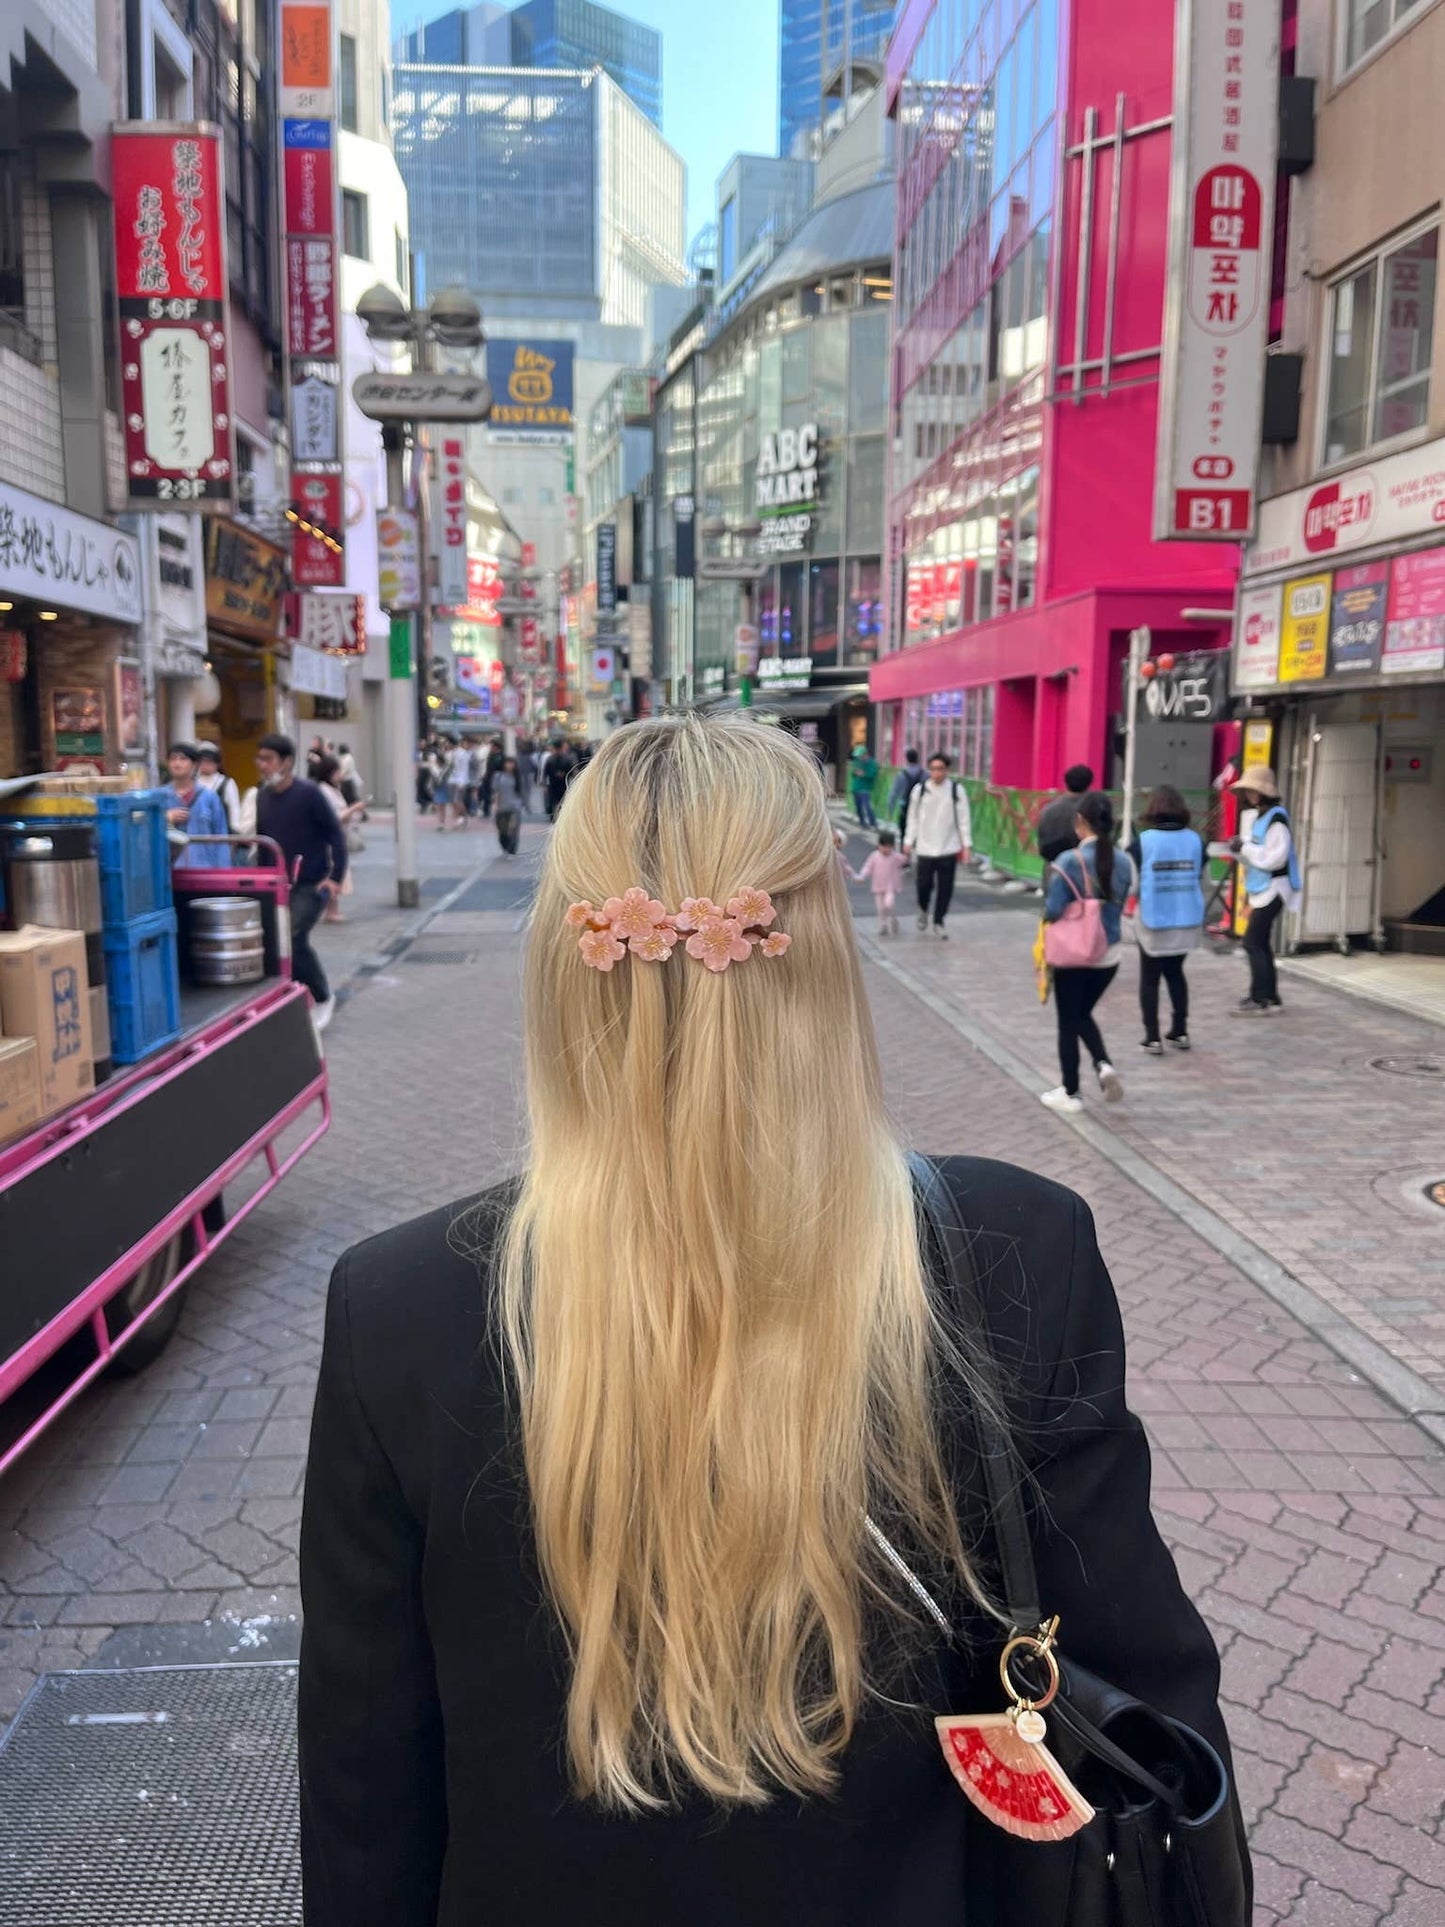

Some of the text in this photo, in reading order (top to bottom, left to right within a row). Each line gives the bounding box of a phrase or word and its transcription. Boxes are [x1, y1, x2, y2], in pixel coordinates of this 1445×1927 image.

[134, 185, 170, 293] お好み焼
[173, 139, 207, 293] 築地もんじゃ
[1207, 175, 1245, 322] 마약포차
[756, 467, 818, 506] MART
[757, 422, 818, 476] ABC
[1189, 496, 1233, 529] B1
